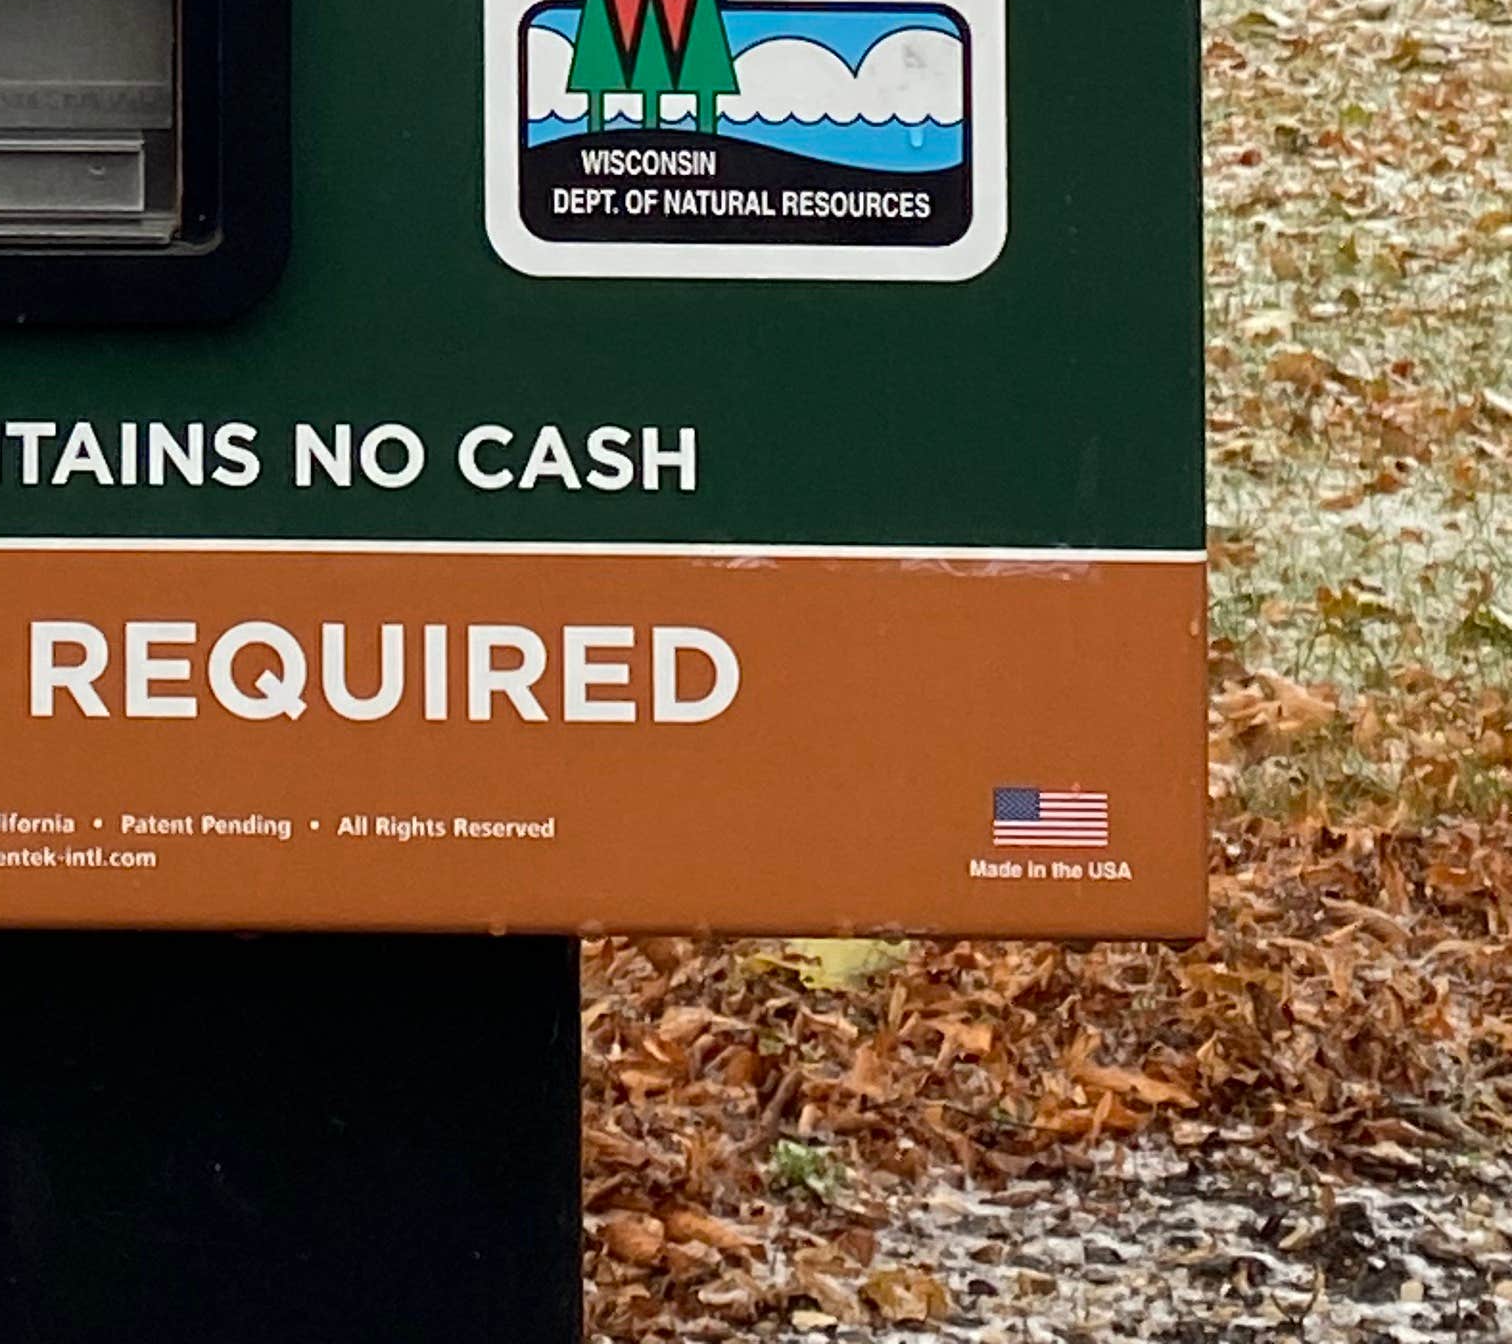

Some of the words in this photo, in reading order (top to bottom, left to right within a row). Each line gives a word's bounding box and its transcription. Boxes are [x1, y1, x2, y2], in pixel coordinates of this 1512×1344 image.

[582, 151, 716, 175] WISCONSIN
[554, 188, 618, 214] DEPT.
[626, 190, 657, 214] OF
[664, 190, 775, 217] NATURAL
[785, 192, 930, 218] RESOURCES
[295, 423, 425, 488] NO
[458, 425, 696, 491] CASH
[30, 621, 740, 723] REQUIRED
[121, 814, 194, 836] Patent
[201, 813, 292, 841] Pending
[337, 814, 368, 836] All
[375, 815, 447, 842] Rights
[453, 817, 555, 838] Reserved
[970, 860, 1022, 878] Made
[1028, 860, 1046, 879] in
[1052, 862, 1083, 879] the
[1088, 862, 1132, 879] USA
